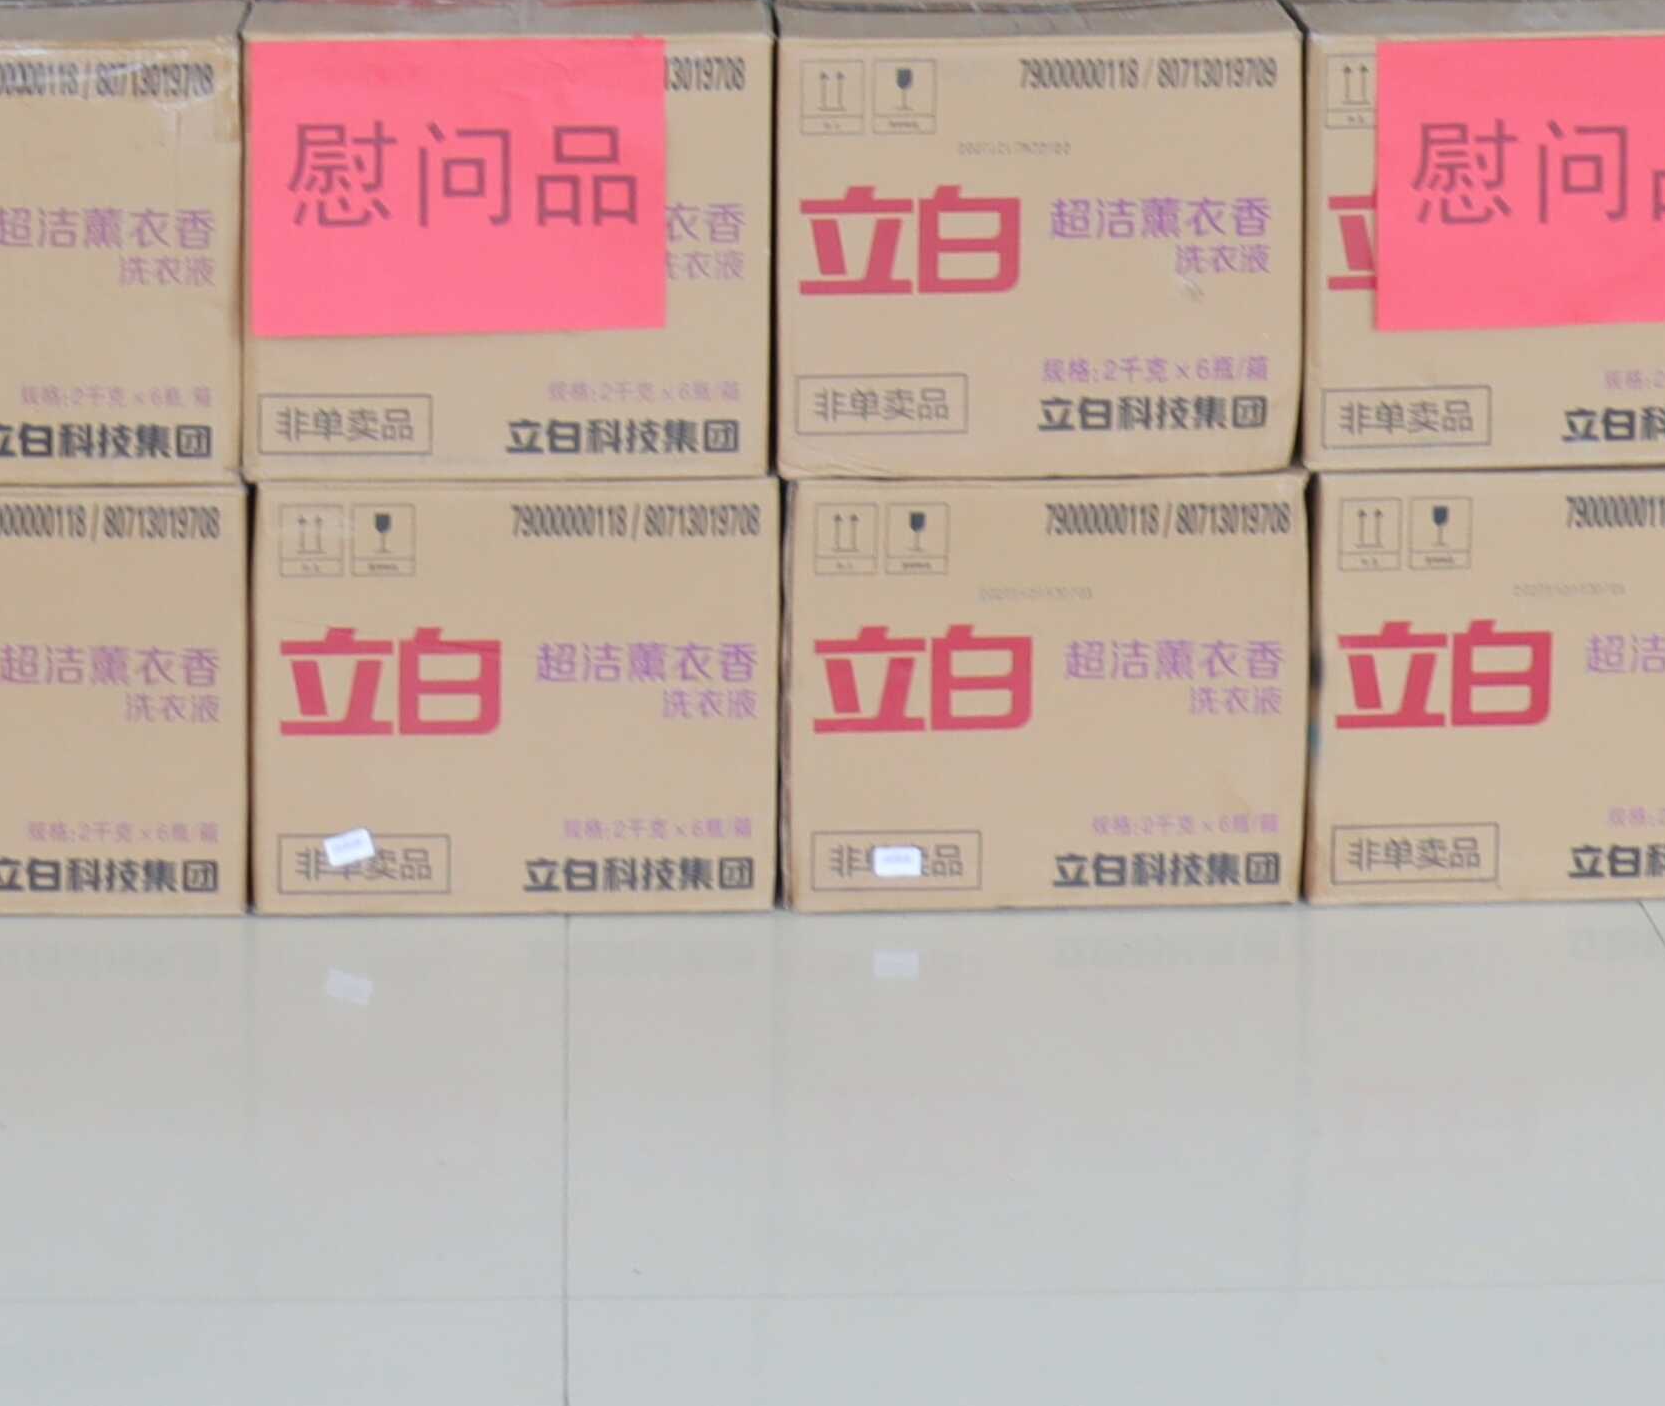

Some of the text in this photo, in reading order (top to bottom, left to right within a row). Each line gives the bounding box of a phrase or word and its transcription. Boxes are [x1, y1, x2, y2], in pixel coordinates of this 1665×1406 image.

[289, 121, 638, 228] 慰问品
[1051, 197, 1269, 242] 超洁薰衣香
[799, 185, 1022, 297] 立白
[1176, 244, 1269, 275] 洗衣液
[119, 256, 214, 287] 洗衣液
[277, 407, 414, 442] 非单卖品
[815, 388, 949, 425] 非单卖品
[1038, 395, 1268, 431] 立白科技集团
[1341, 399, 1473, 437] 非单卖品
[506, 419, 739, 454] 立白科技集团
[0, 644, 218, 689] 超洁薰衣香
[537, 642, 756, 686] 超洁薰衣香
[813, 624, 1033, 734] 立白
[1066, 639, 1282, 683] 超洁薰衣香
[1335, 619, 1553, 730] 立白
[280, 627, 502, 736] 立白
[125, 692, 219, 723] 洗衣液
[663, 689, 756, 719] 洗衣液
[1190, 686, 1281, 716] 洗衣液
[1053, 852, 1281, 888] 立白科技集团
[1346, 834, 1481, 873] 非单卖品
[524, 857, 754, 893] 立白科技集团
